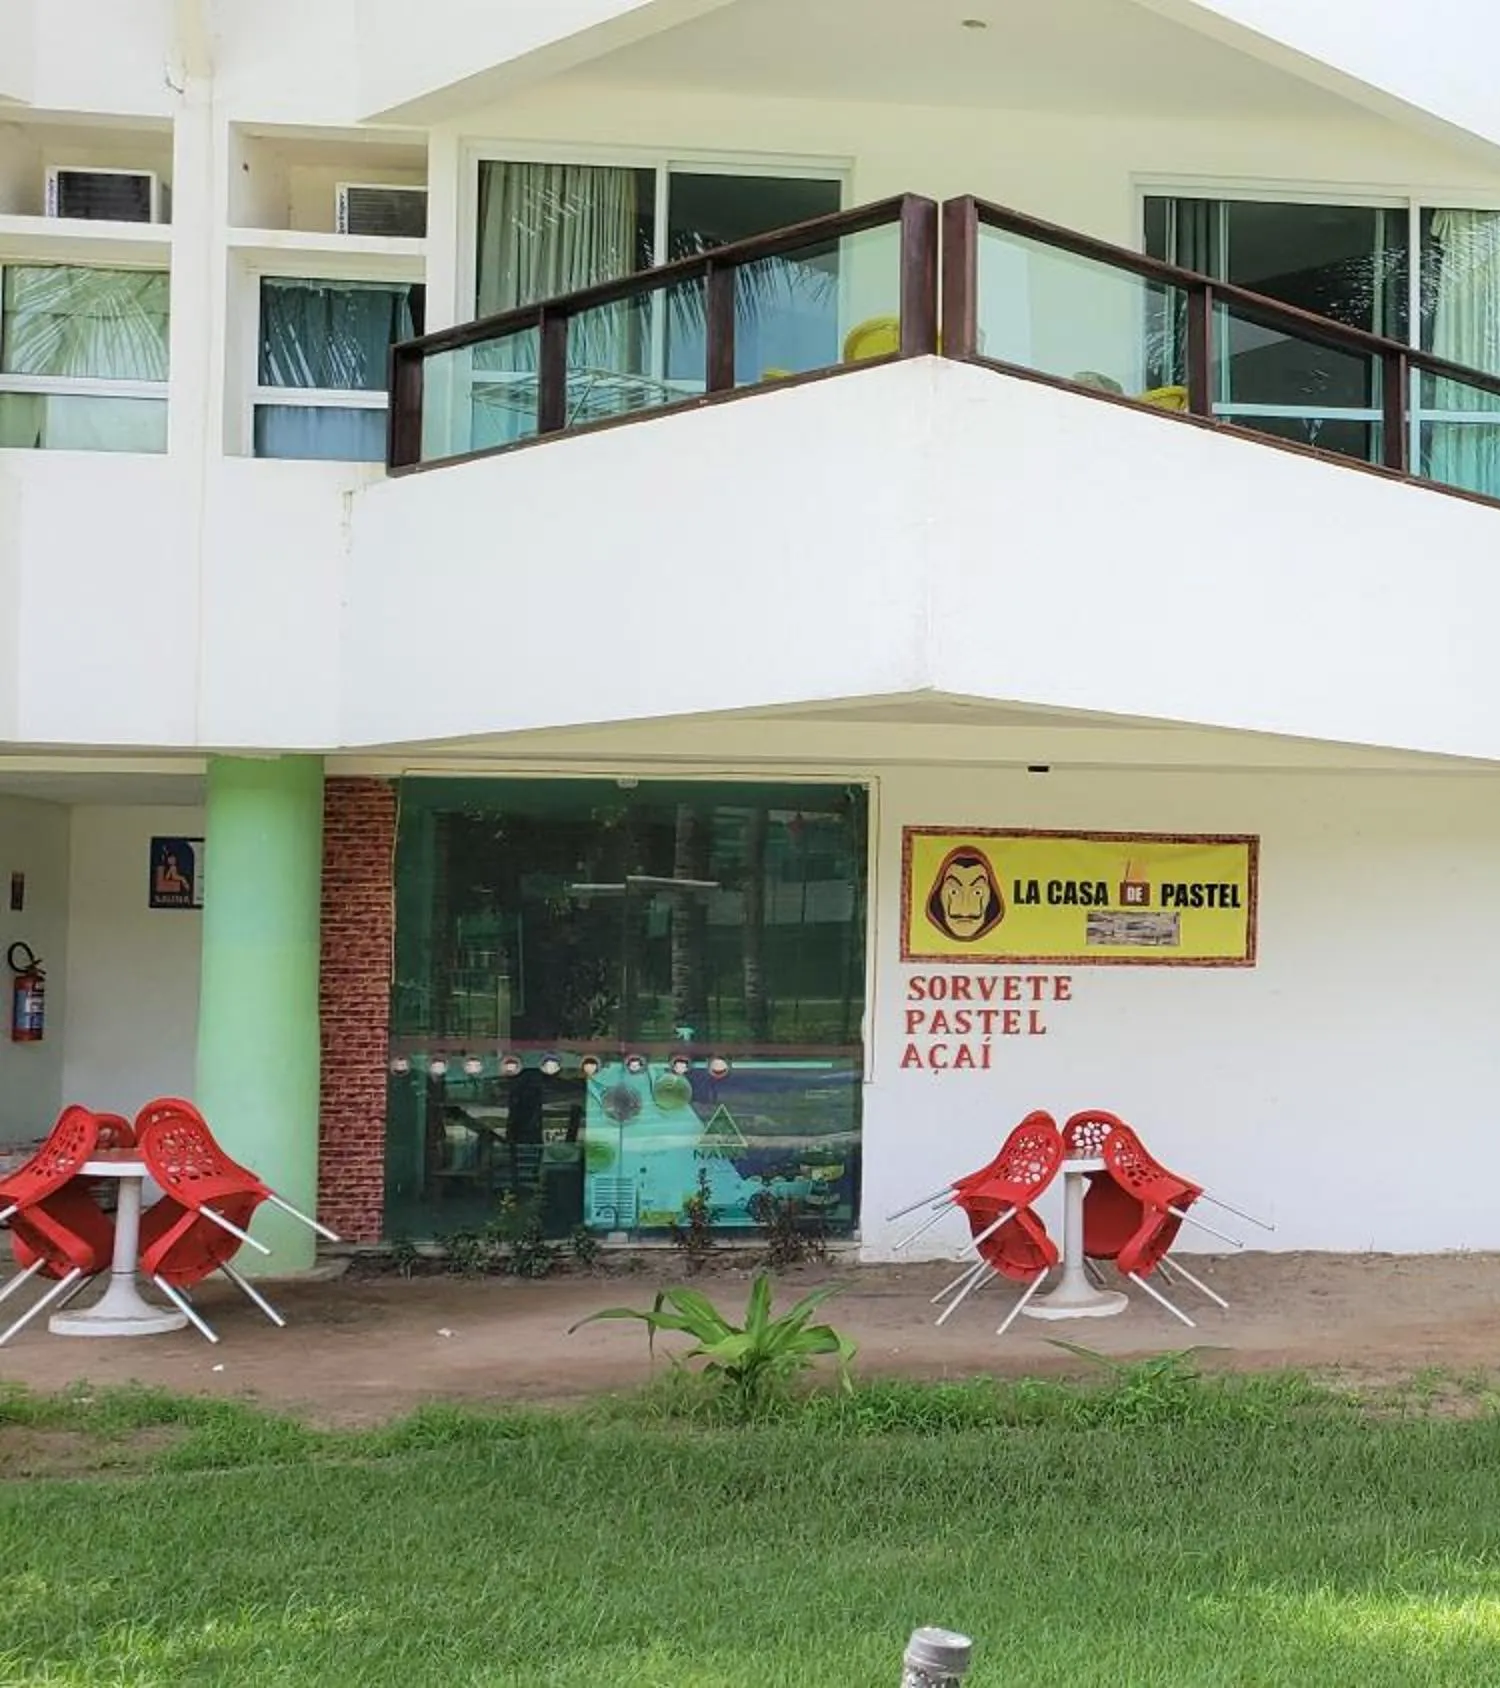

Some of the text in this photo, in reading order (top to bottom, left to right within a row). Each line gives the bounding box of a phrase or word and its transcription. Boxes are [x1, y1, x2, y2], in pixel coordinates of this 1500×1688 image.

[1013, 879, 1241, 908] LA CASA DE PASTEL
[907, 975, 1072, 1001] SORVETE
[904, 1010, 1047, 1035] PASTEL
[900, 1036, 991, 1075] AÇAÍ
